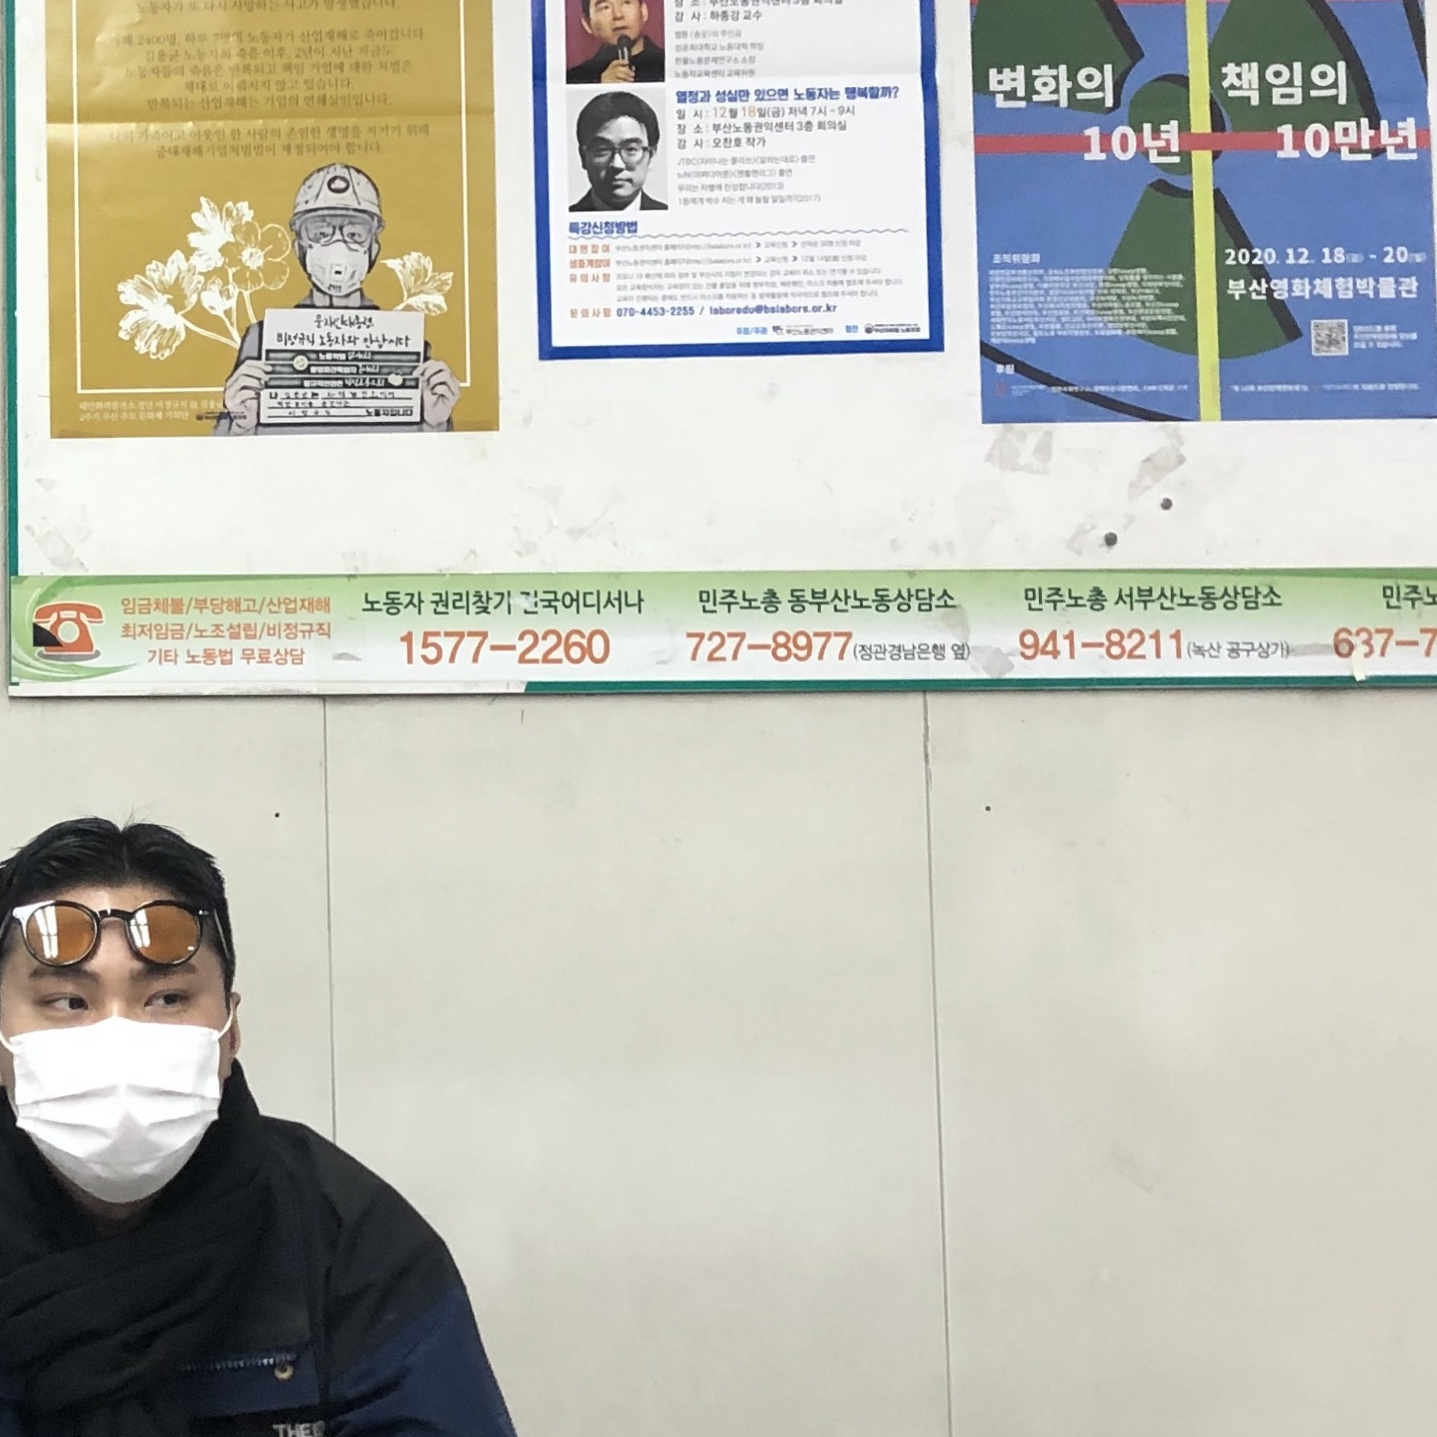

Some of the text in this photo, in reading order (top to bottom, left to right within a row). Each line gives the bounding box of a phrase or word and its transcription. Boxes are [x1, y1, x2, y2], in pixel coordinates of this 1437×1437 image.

[676, 86, 899, 104] 열정과 성실만 있으면 노동자는 행복할까?
[988, 64, 1114, 109] 변화의
[1220, 61, 1348, 105] 책임의
[746, 136, 766, 147] 작가
[1082, 120, 1181, 164] 10년
[1276, 118, 1418, 161] 10만년
[1227, 276, 1419, 300] 부산영화체험박물관
[617, 306, 695, 317] 070-4453-2255
[361, 590, 424, 616] 노동자
[430, 590, 512, 616] 권리찾기
[698, 587, 957, 614] 민주노총 동부산노동상담소
[1024, 585, 1283, 612] 민주노총 서부산노동상담소
[147, 647, 305, 666] 기타 노동법 무료상담
[400, 628, 611, 665] 1577-2260
[686, 630, 853, 662] 727-8977
[1018, 628, 1183, 660] 941-8211
